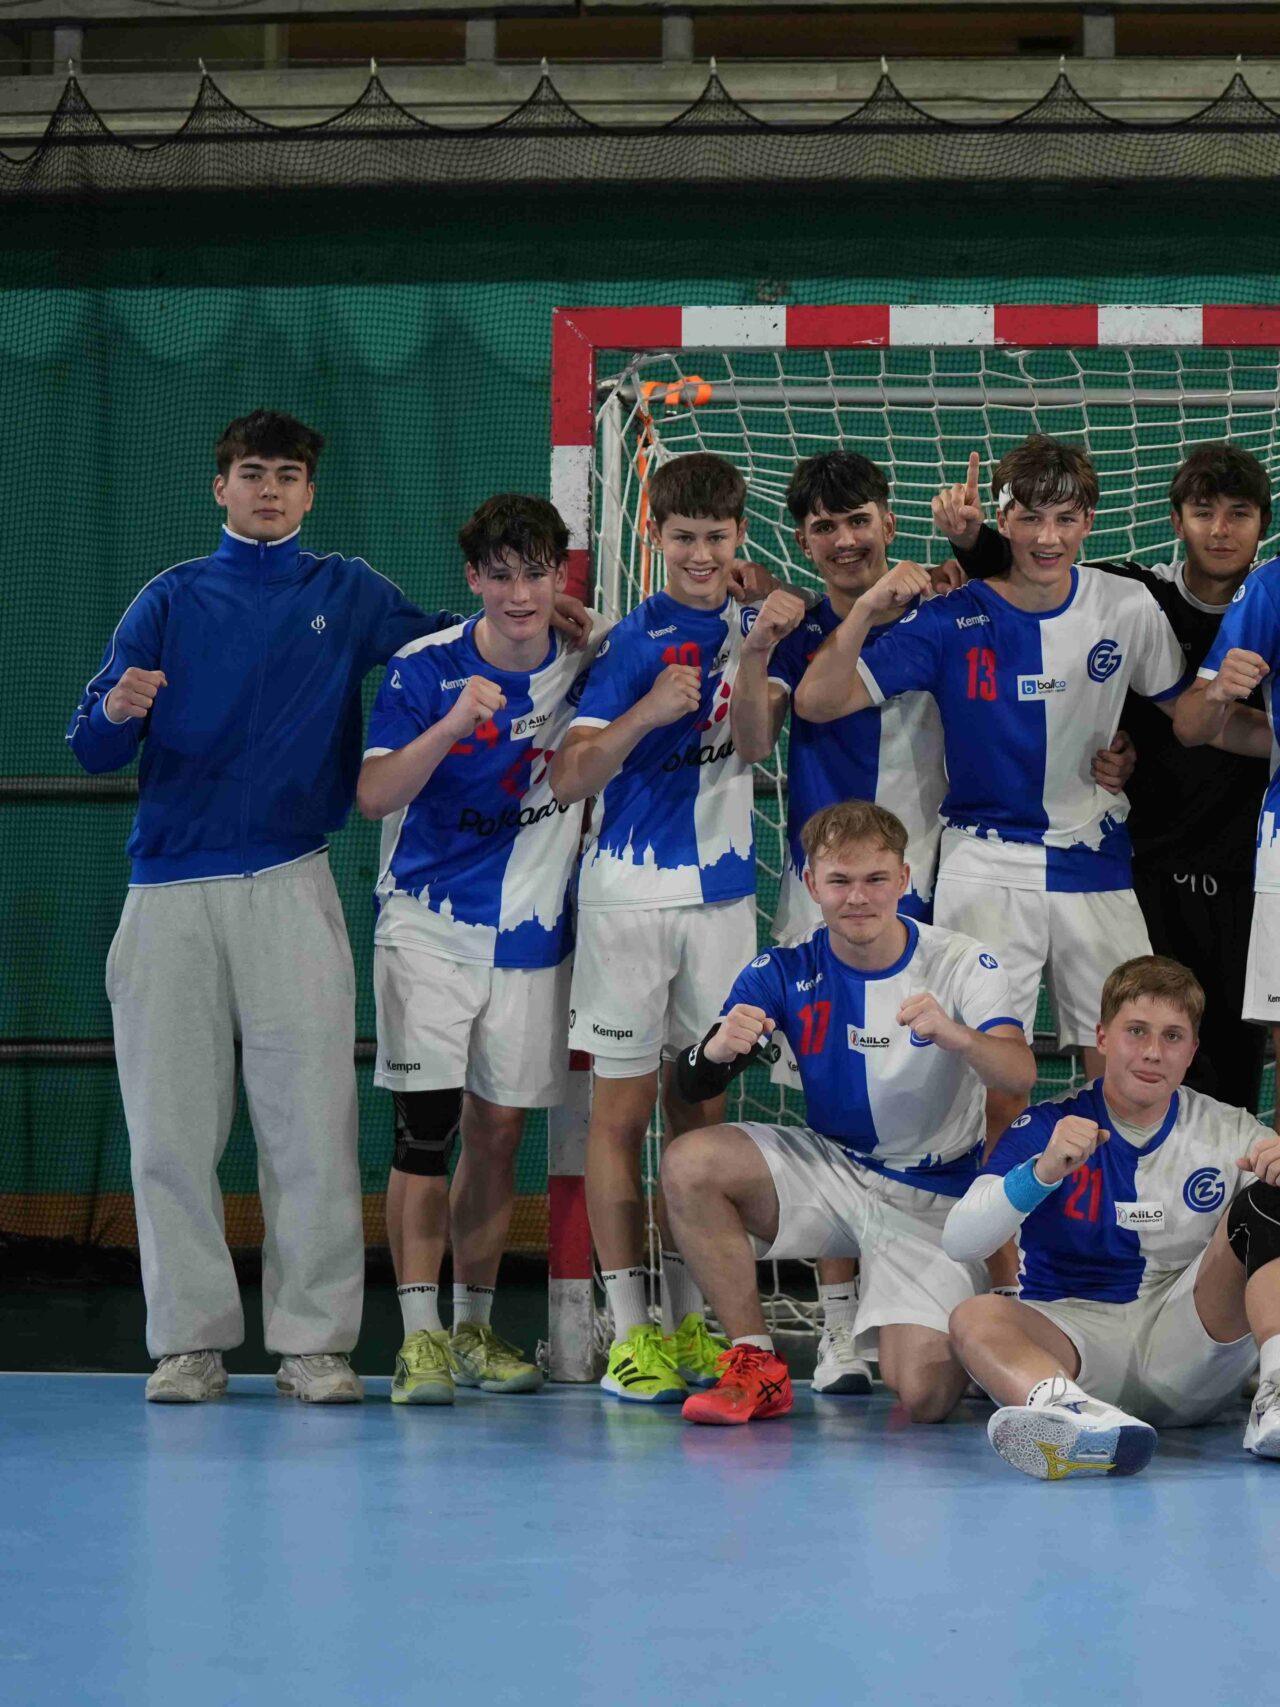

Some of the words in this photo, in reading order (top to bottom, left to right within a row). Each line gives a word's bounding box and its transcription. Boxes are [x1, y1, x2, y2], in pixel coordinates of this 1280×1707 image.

[956, 614, 990, 629] Kempa
[965, 647, 997, 700] 13
[1037, 678, 1066, 690] ballco
[592, 1023, 634, 1041] Kempa
[797, 1000, 833, 1056] 17
[386, 1059, 421, 1074] Kempa
[1064, 1166, 1103, 1223] 21
